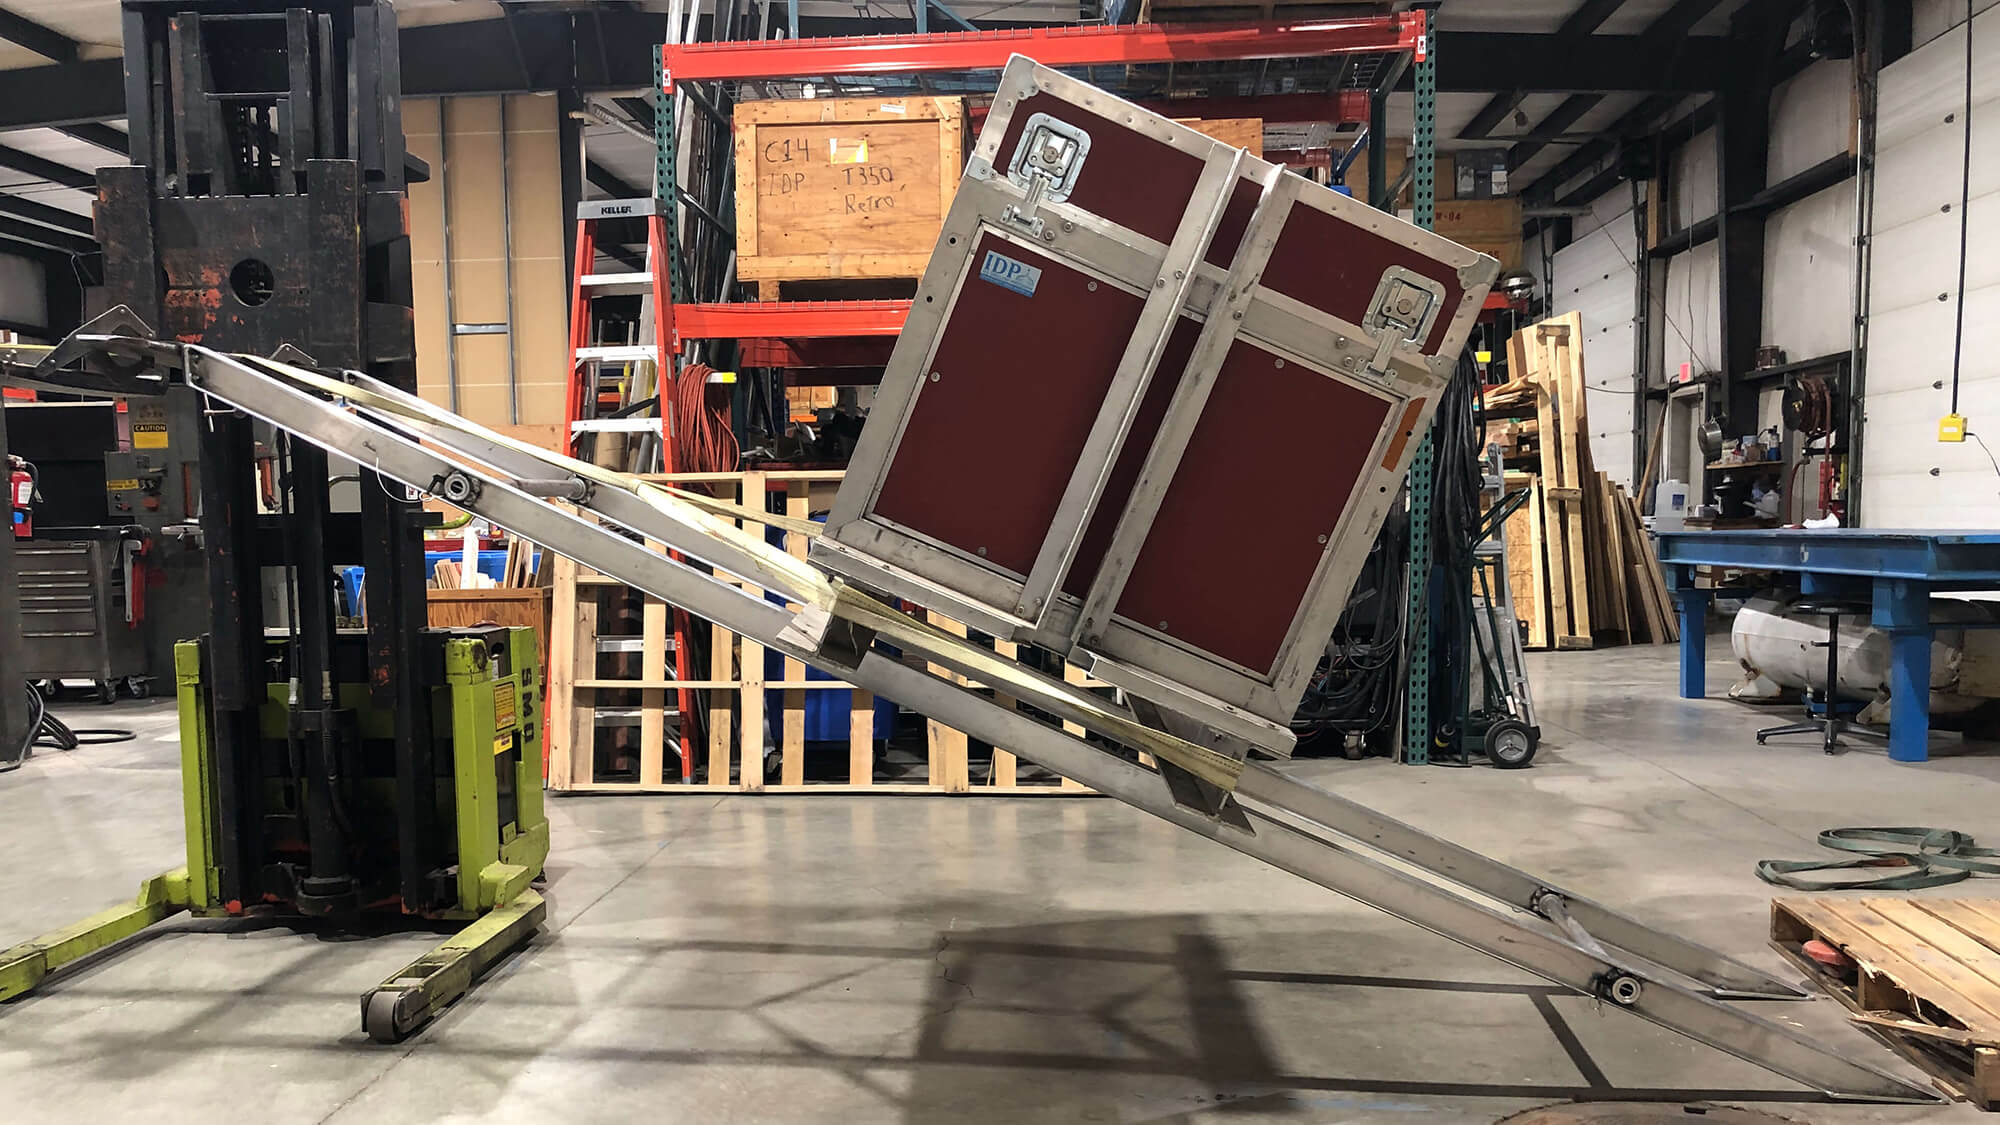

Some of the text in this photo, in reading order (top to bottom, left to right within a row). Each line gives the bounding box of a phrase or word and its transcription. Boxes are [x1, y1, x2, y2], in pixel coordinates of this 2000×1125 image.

[765, 138, 809, 163] C14
[760, 172, 805, 197] IDP
[842, 166, 894, 186] T350
[601, 206, 632, 215] KELLER
[845, 193, 895, 215] Retro
[985, 254, 1021, 278] IDP
